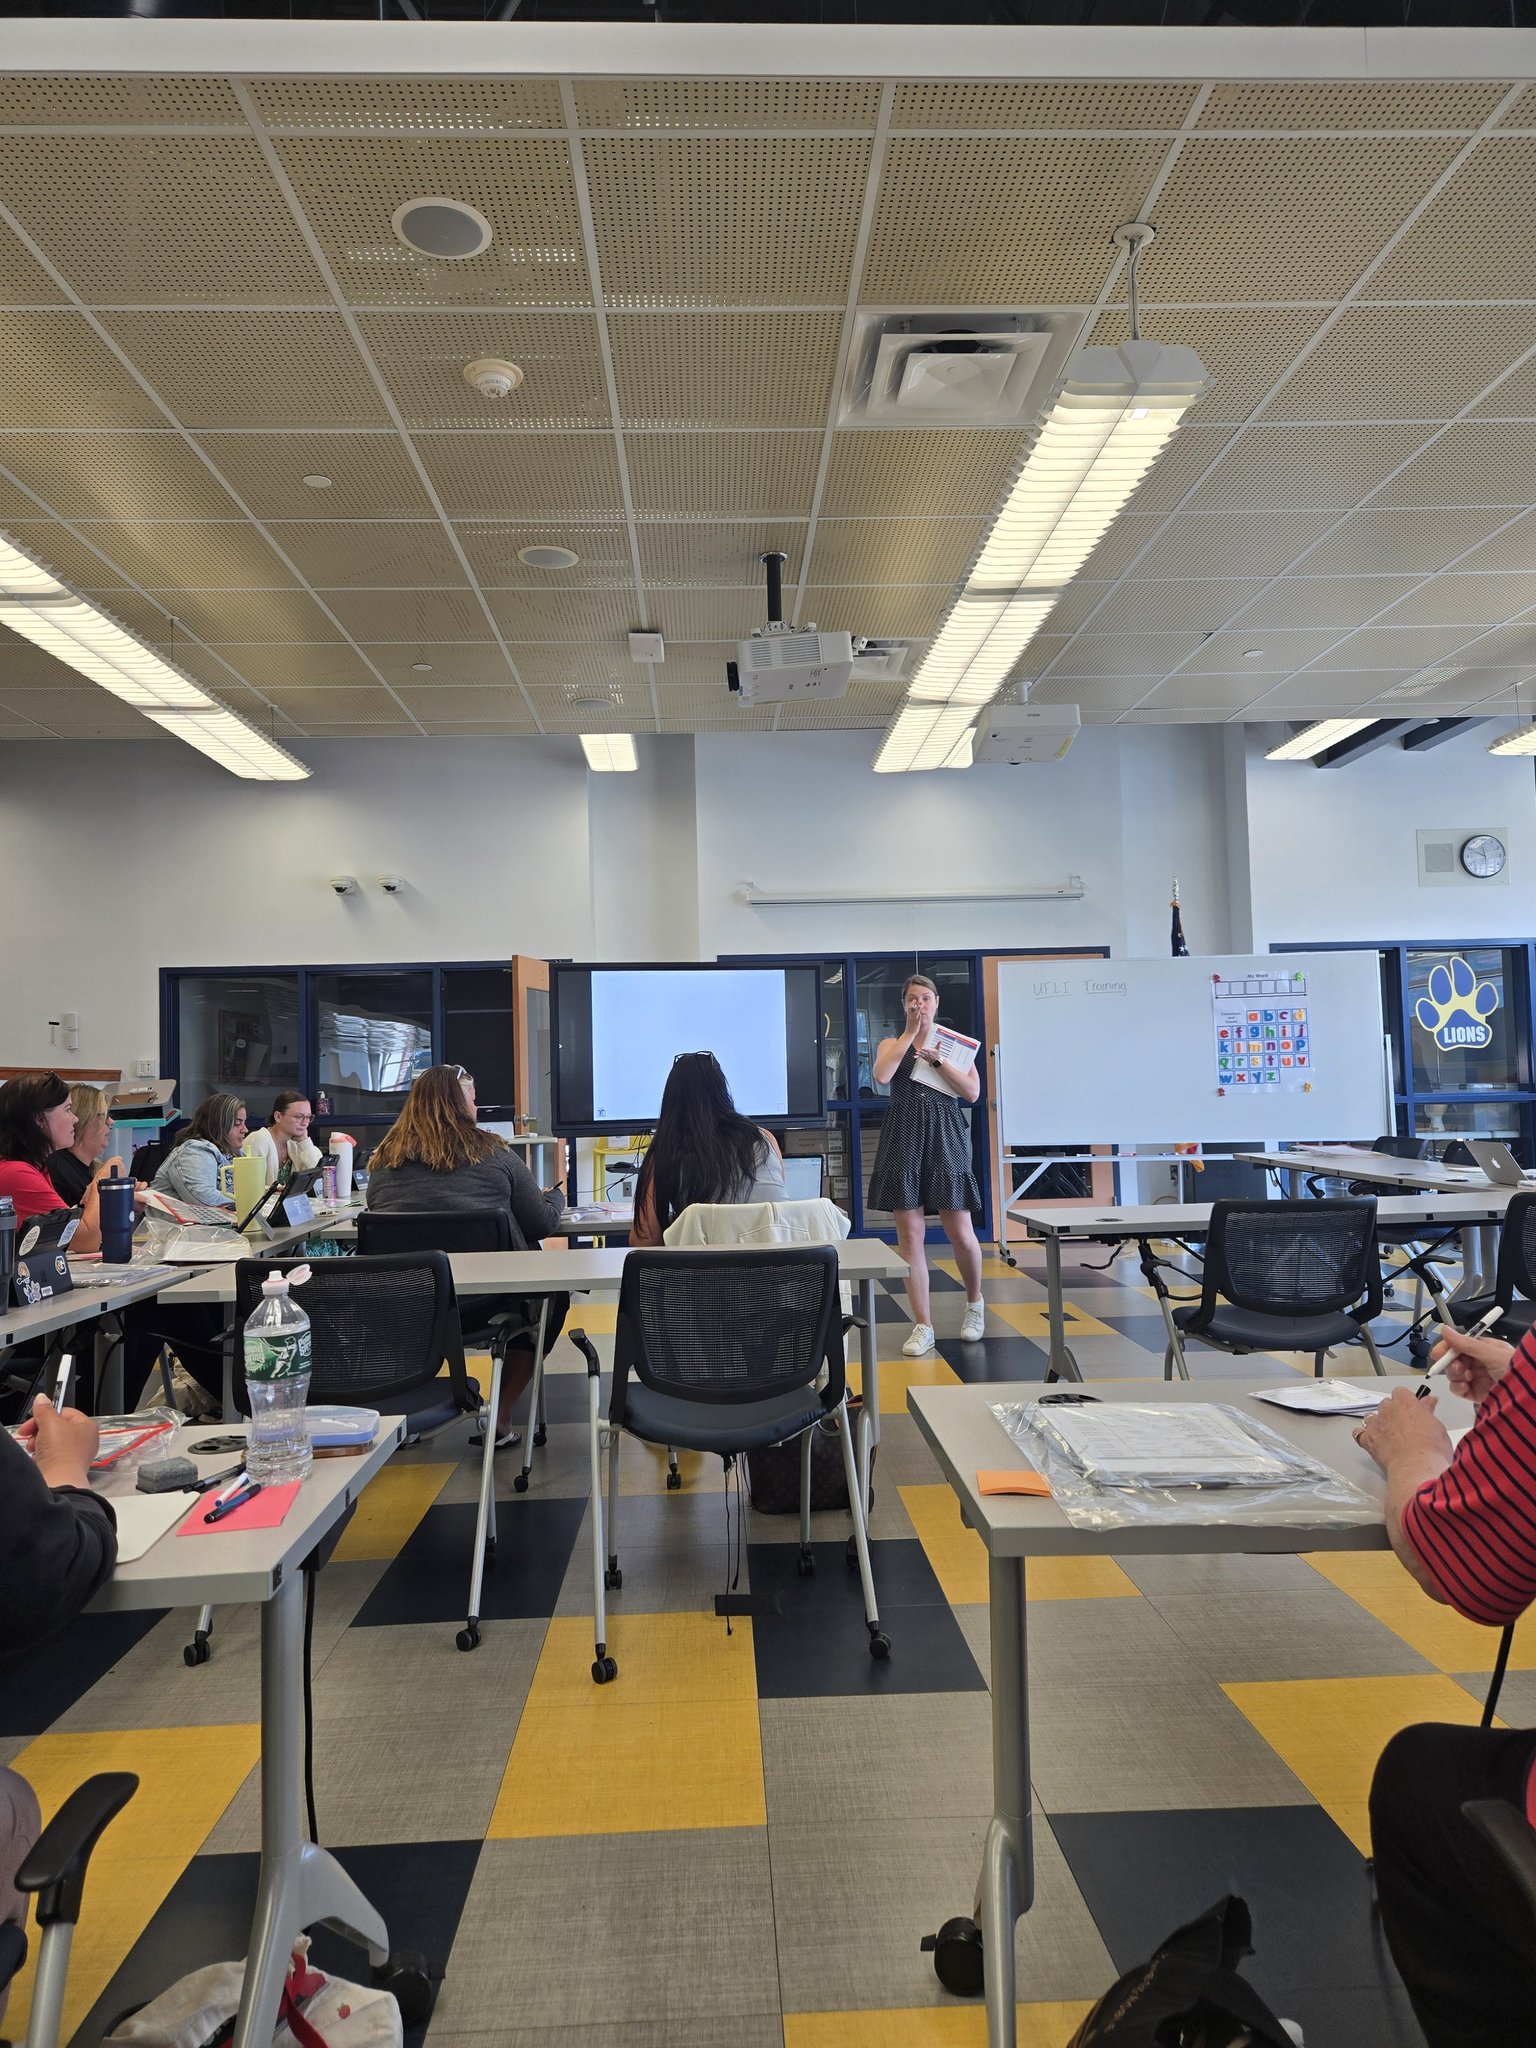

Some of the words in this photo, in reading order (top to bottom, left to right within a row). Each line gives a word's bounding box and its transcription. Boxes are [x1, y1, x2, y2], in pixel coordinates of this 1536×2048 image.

[1033, 981, 1071, 996] UFLI
[1080, 980, 1127, 996] Training
[1248, 1012, 1258, 1020] a
[1264, 1010, 1273, 1021] b
[1295, 1008, 1304, 1020] d
[1220, 1030, 1228, 1038] e
[1236, 1027, 1242, 1038] f
[1250, 1027, 1259, 1038] g
[1266, 1027, 1274, 1038] h
[1282, 1026, 1287, 1036] i
[1298, 1024, 1304, 1037] j
[1443, 1026, 1486, 1044] LIONS
[1220, 1042, 1228, 1052] k
[1237, 1043, 1241, 1054] l
[1248, 1044, 1261, 1052] m
[1266, 1042, 1275, 1050] n
[1281, 1041, 1291, 1049] o
[1296, 1040, 1305, 1051] p
[1220, 1058, 1229, 1069] q
[1237, 1058, 1244, 1066] r
[1268, 1056, 1274, 1066] t
[1282, 1058, 1291, 1066] u
[1298, 1057, 1305, 1065] v
[1220, 1075, 1232, 1083] w
[1237, 1074, 1245, 1082] x
[1252, 1072, 1261, 1083] y
[1267, 1072, 1275, 1080] z
